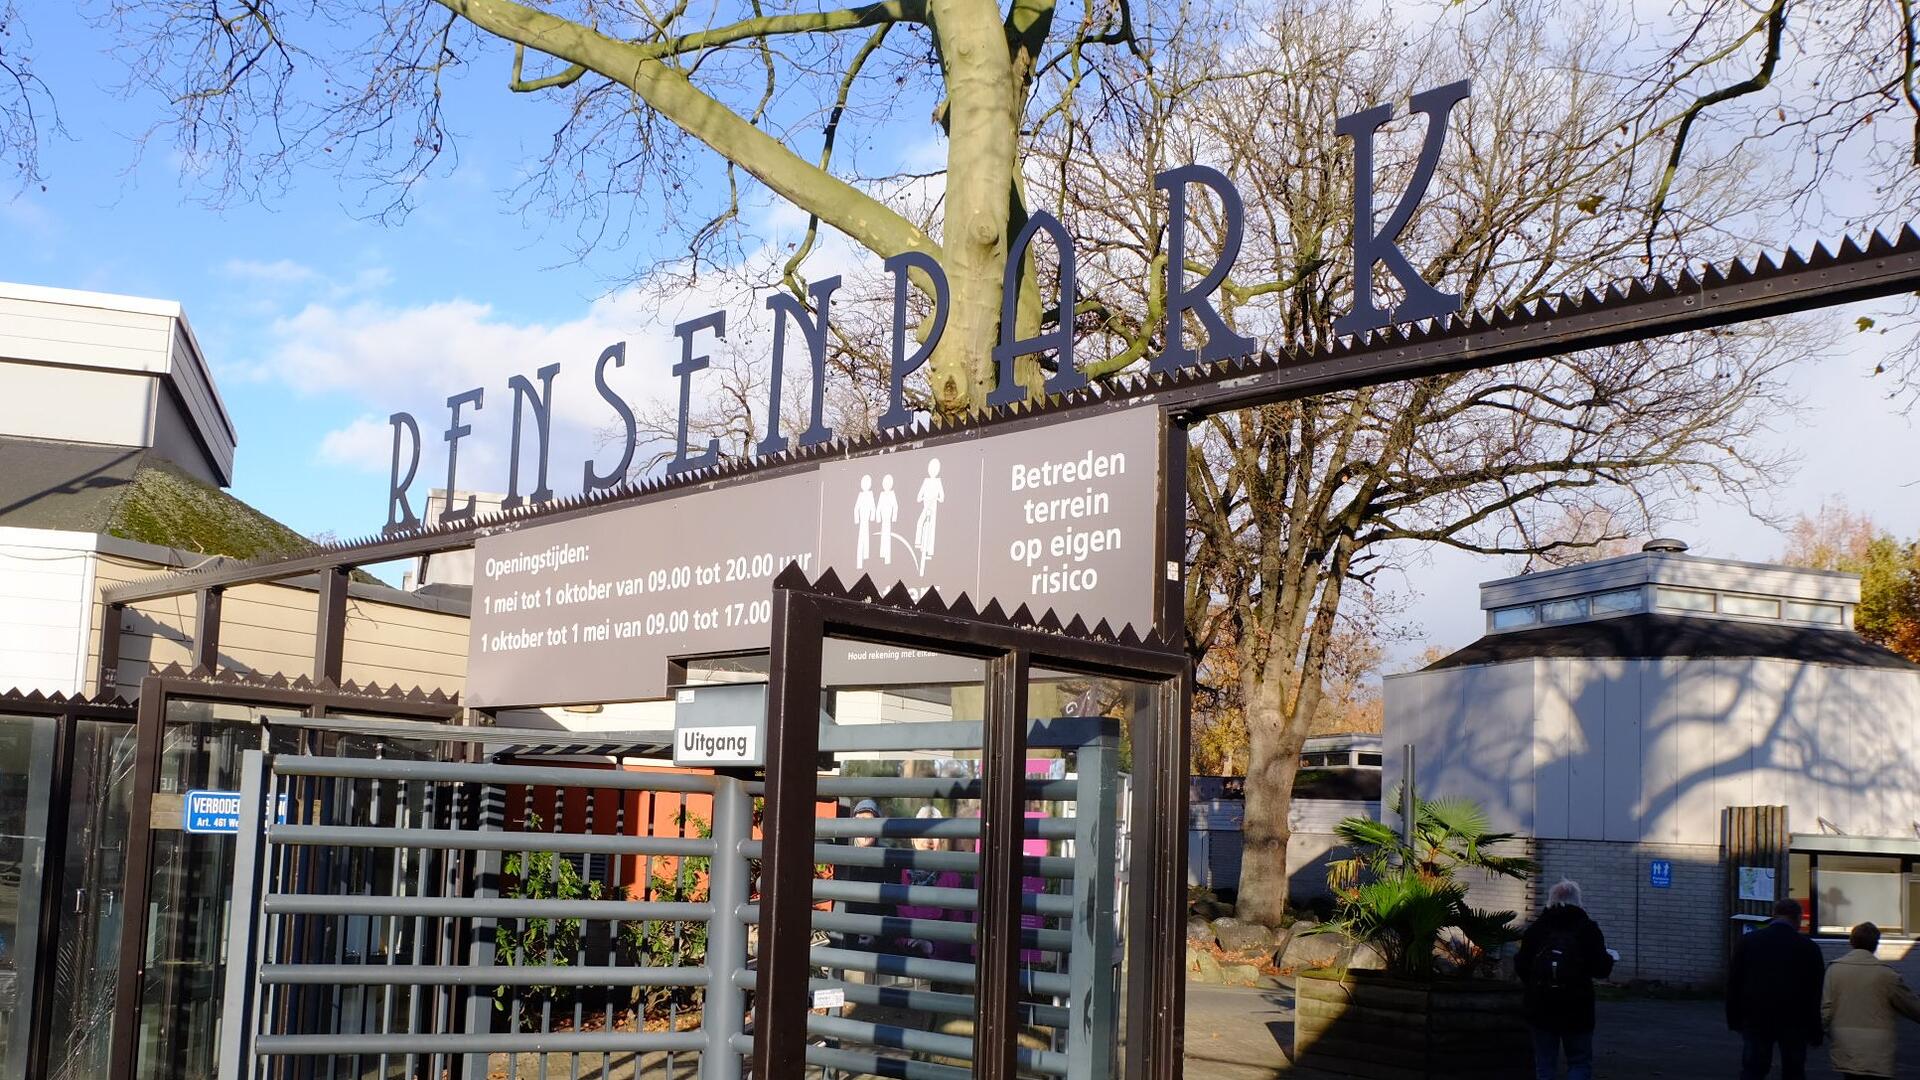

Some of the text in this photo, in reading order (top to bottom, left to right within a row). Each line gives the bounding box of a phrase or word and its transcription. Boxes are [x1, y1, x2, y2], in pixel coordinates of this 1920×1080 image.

[382, 80, 1470, 534] RENSENPARK
[1011, 450, 1125, 492] Betreden
[1023, 487, 1109, 524] terrein
[485, 543, 589, 580] Openingstijden:
[1010, 526, 1121, 567] op eigen
[484, 596, 490, 614] 1
[494, 591, 517, 614] mei
[521, 590, 541, 610] tot
[545, 586, 551, 606] 1
[556, 579, 612, 605] oktober
[616, 577, 643, 597] van
[648, 565, 691, 592] 09.00
[695, 562, 721, 586] tot
[725, 553, 773, 582] 20.00
[1031, 563, 1098, 595] risico
[481, 600, 771, 652] 1 oktober tot 1 mei van 09.00 tot 17.00
[847, 650, 867, 660] Houd
[868, 649, 900, 660] rekening
[901, 650, 916, 659] met
[684, 731, 747, 757] Uitgang
[196, 817, 211, 827] Art.
[213, 817, 227, 827] 461
